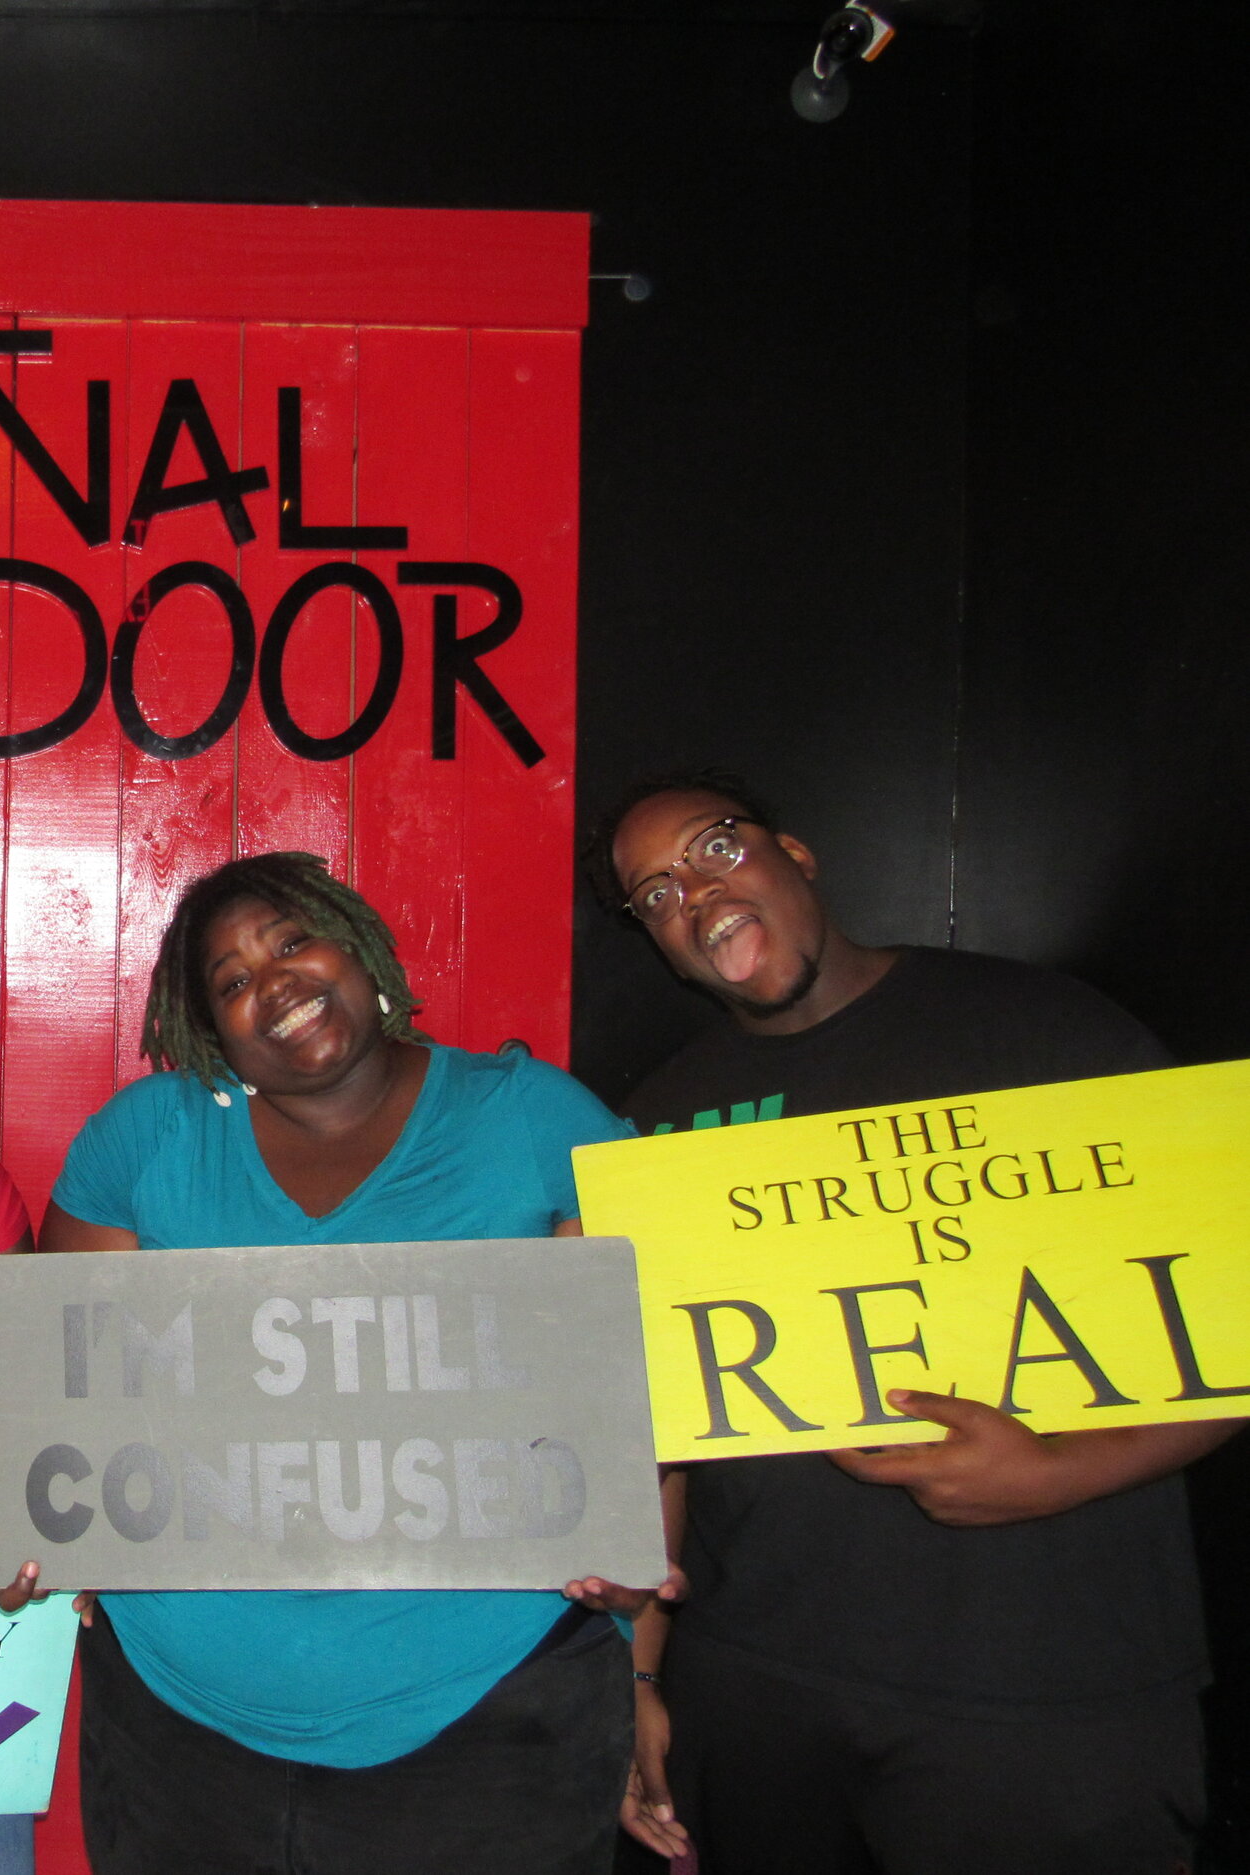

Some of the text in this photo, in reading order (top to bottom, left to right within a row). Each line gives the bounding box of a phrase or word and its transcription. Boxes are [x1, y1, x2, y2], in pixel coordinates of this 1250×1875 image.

[838, 1105, 987, 1163] THE
[728, 1141, 1135, 1232] STRUGGLE
[905, 1215, 972, 1265] IS
[62, 1294, 532, 1399] I'M STILL
[671, 1252, 1250, 1441] REAL
[26, 1437, 587, 1544] CONFUSED
